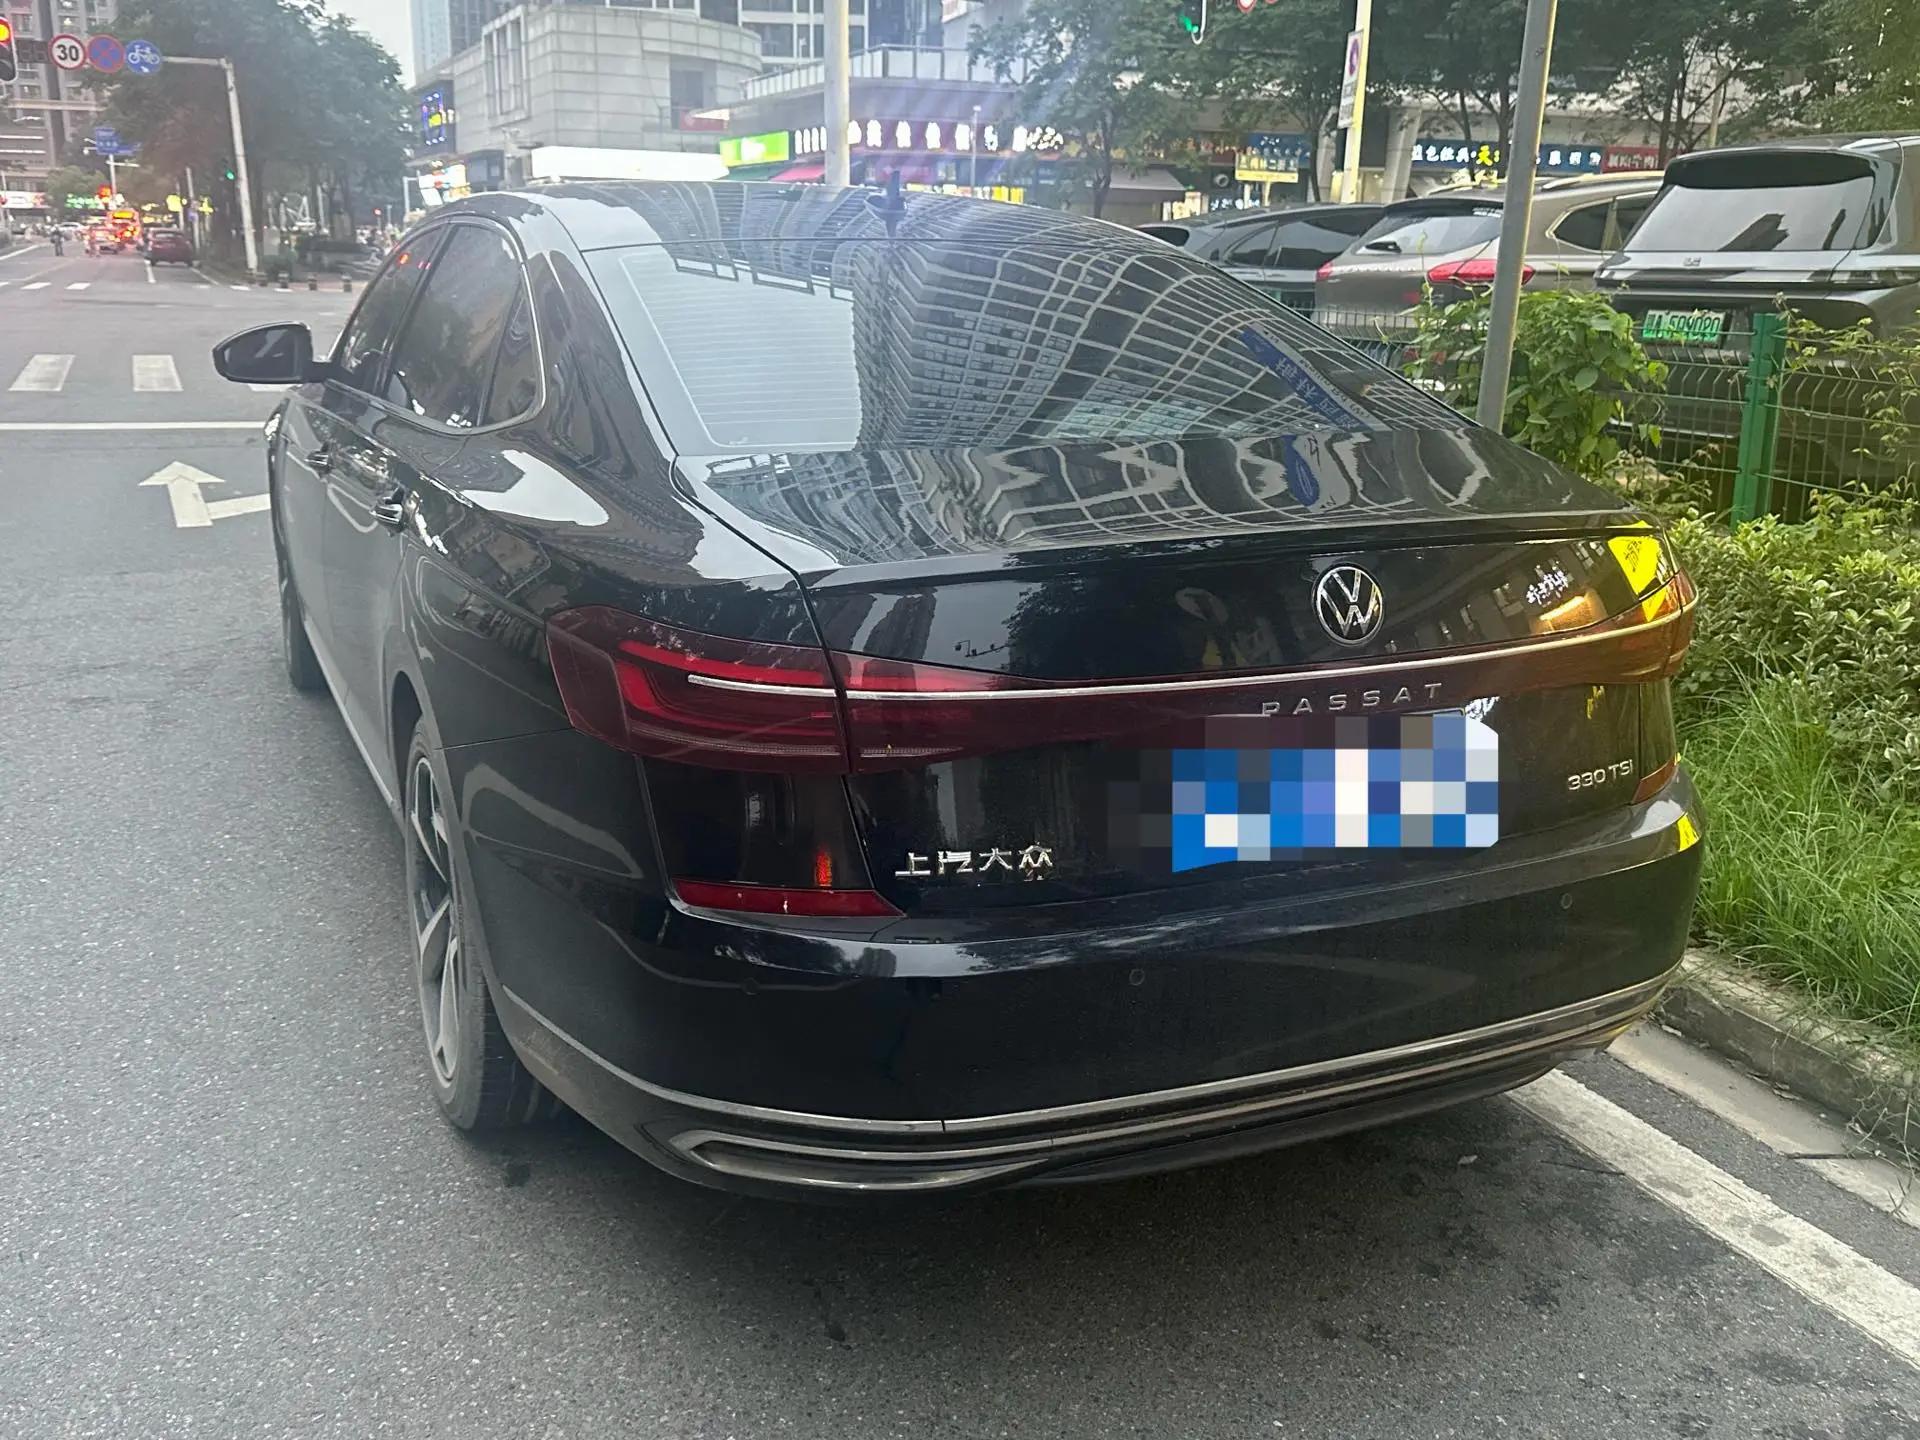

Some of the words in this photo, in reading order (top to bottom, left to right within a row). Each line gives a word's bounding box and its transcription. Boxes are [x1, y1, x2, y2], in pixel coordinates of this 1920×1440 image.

[56, 44, 80, 62] 30
[1262, 682, 1443, 716] PASSAT
[1567, 768, 1607, 791] 330
[895, 841, 1053, 882] 上汽大众
